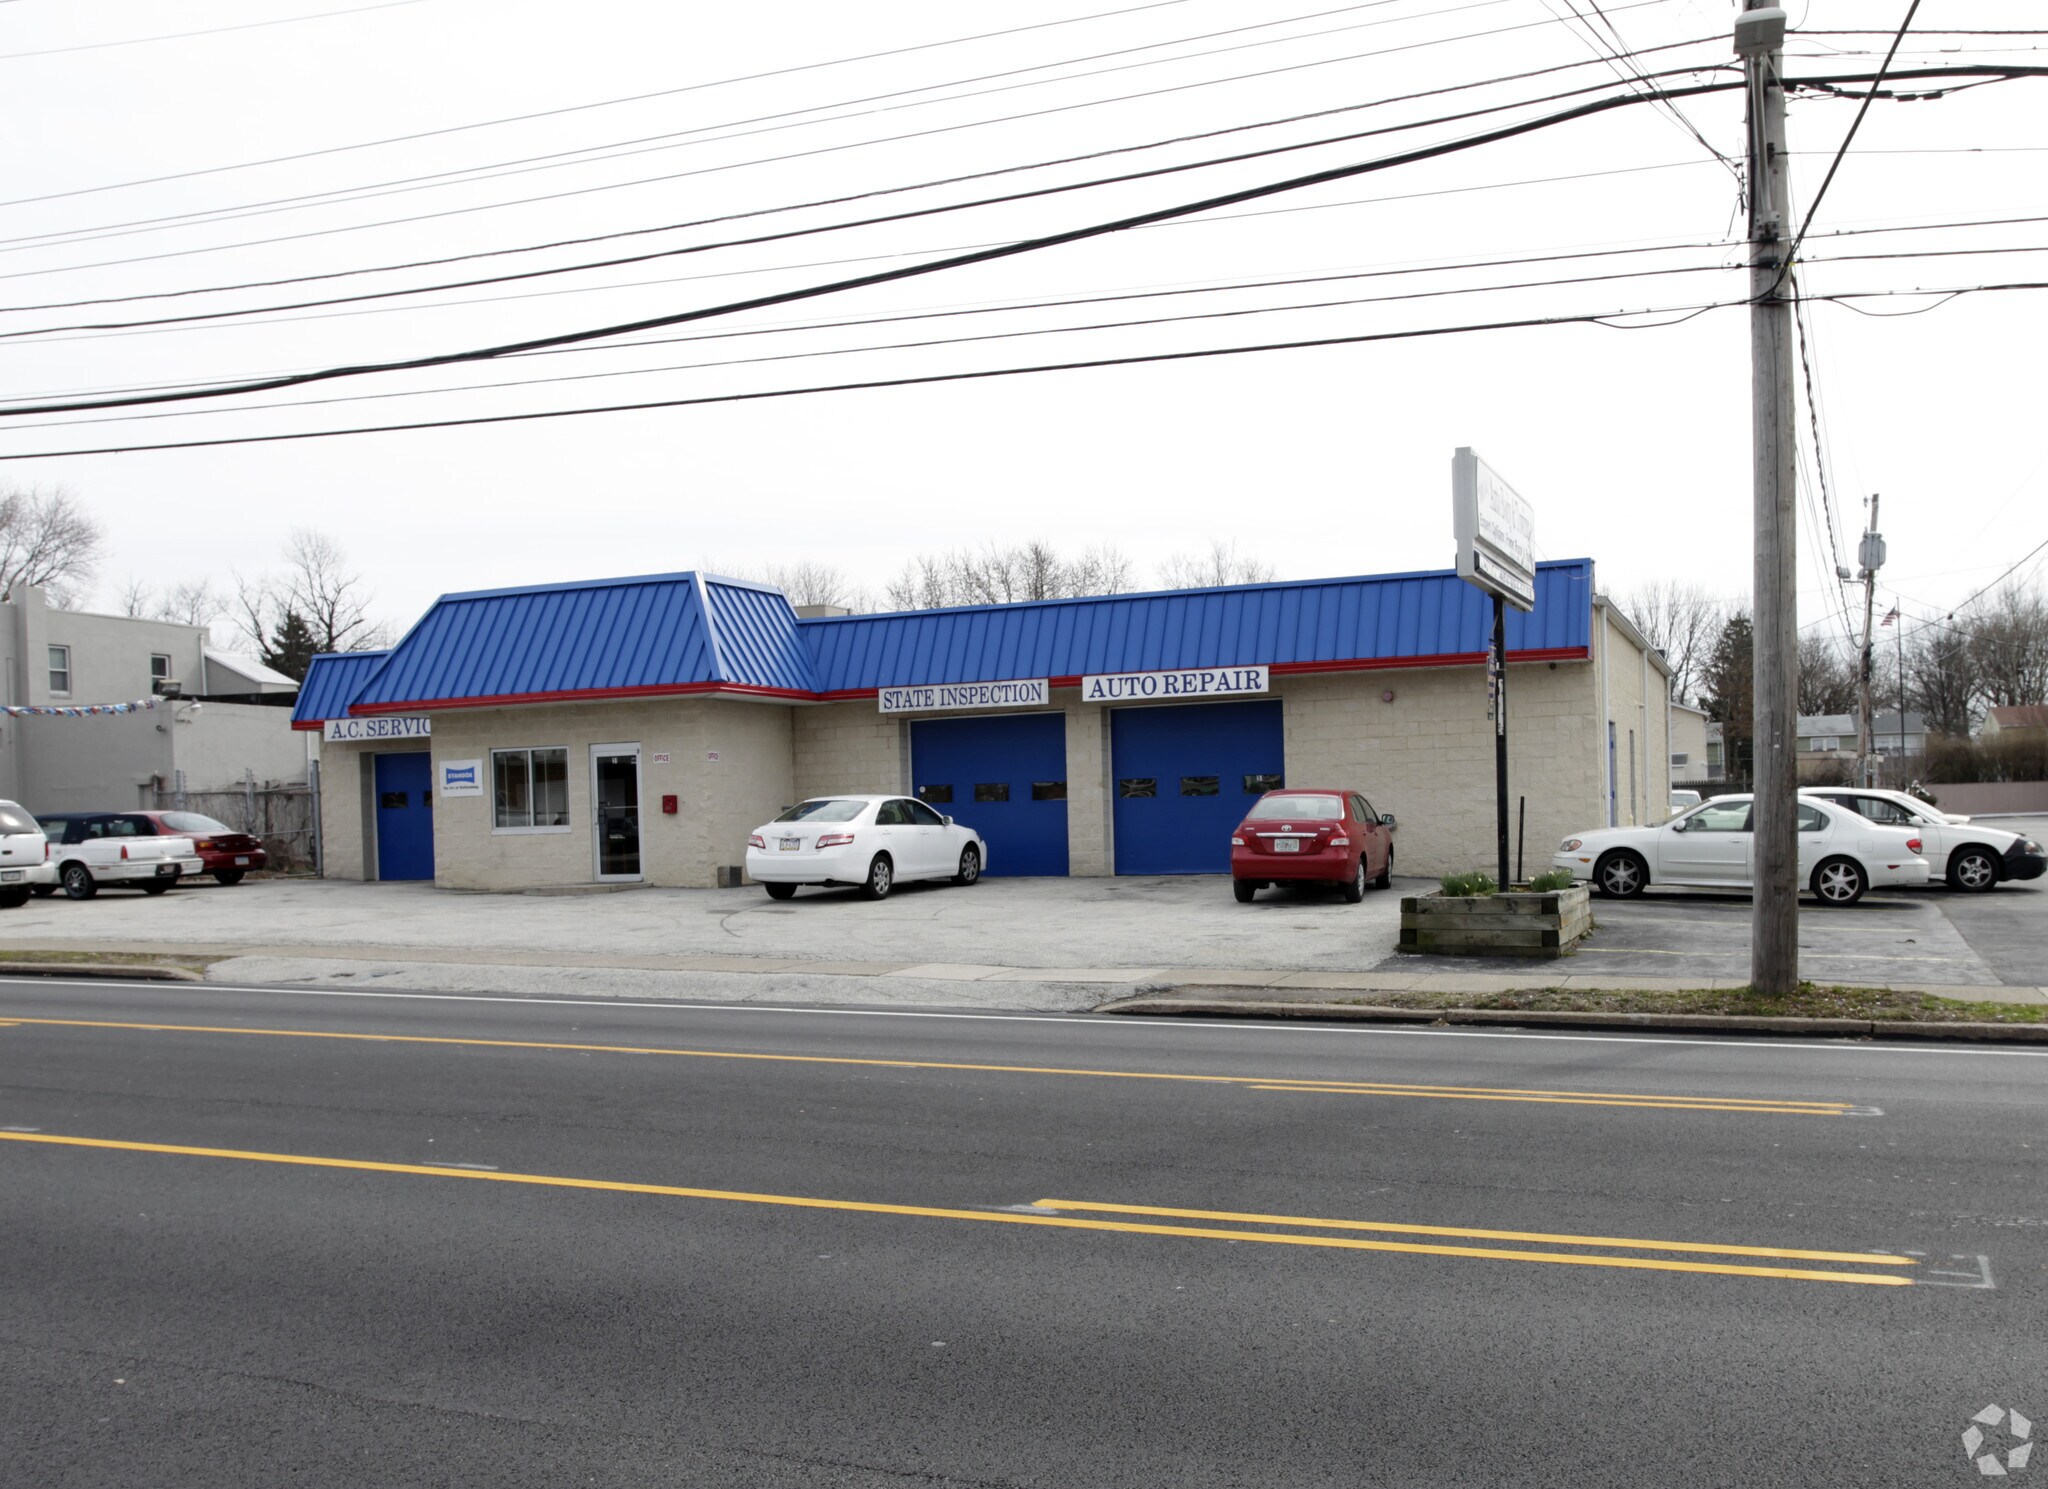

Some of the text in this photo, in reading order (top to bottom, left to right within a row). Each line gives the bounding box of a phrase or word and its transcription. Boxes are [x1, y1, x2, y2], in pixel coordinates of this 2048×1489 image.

[884, 682, 1042, 709] STATE INSPECTION
[1089, 670, 1261, 698] AUTO REPAIR
[331, 721, 363, 739] A.C.
